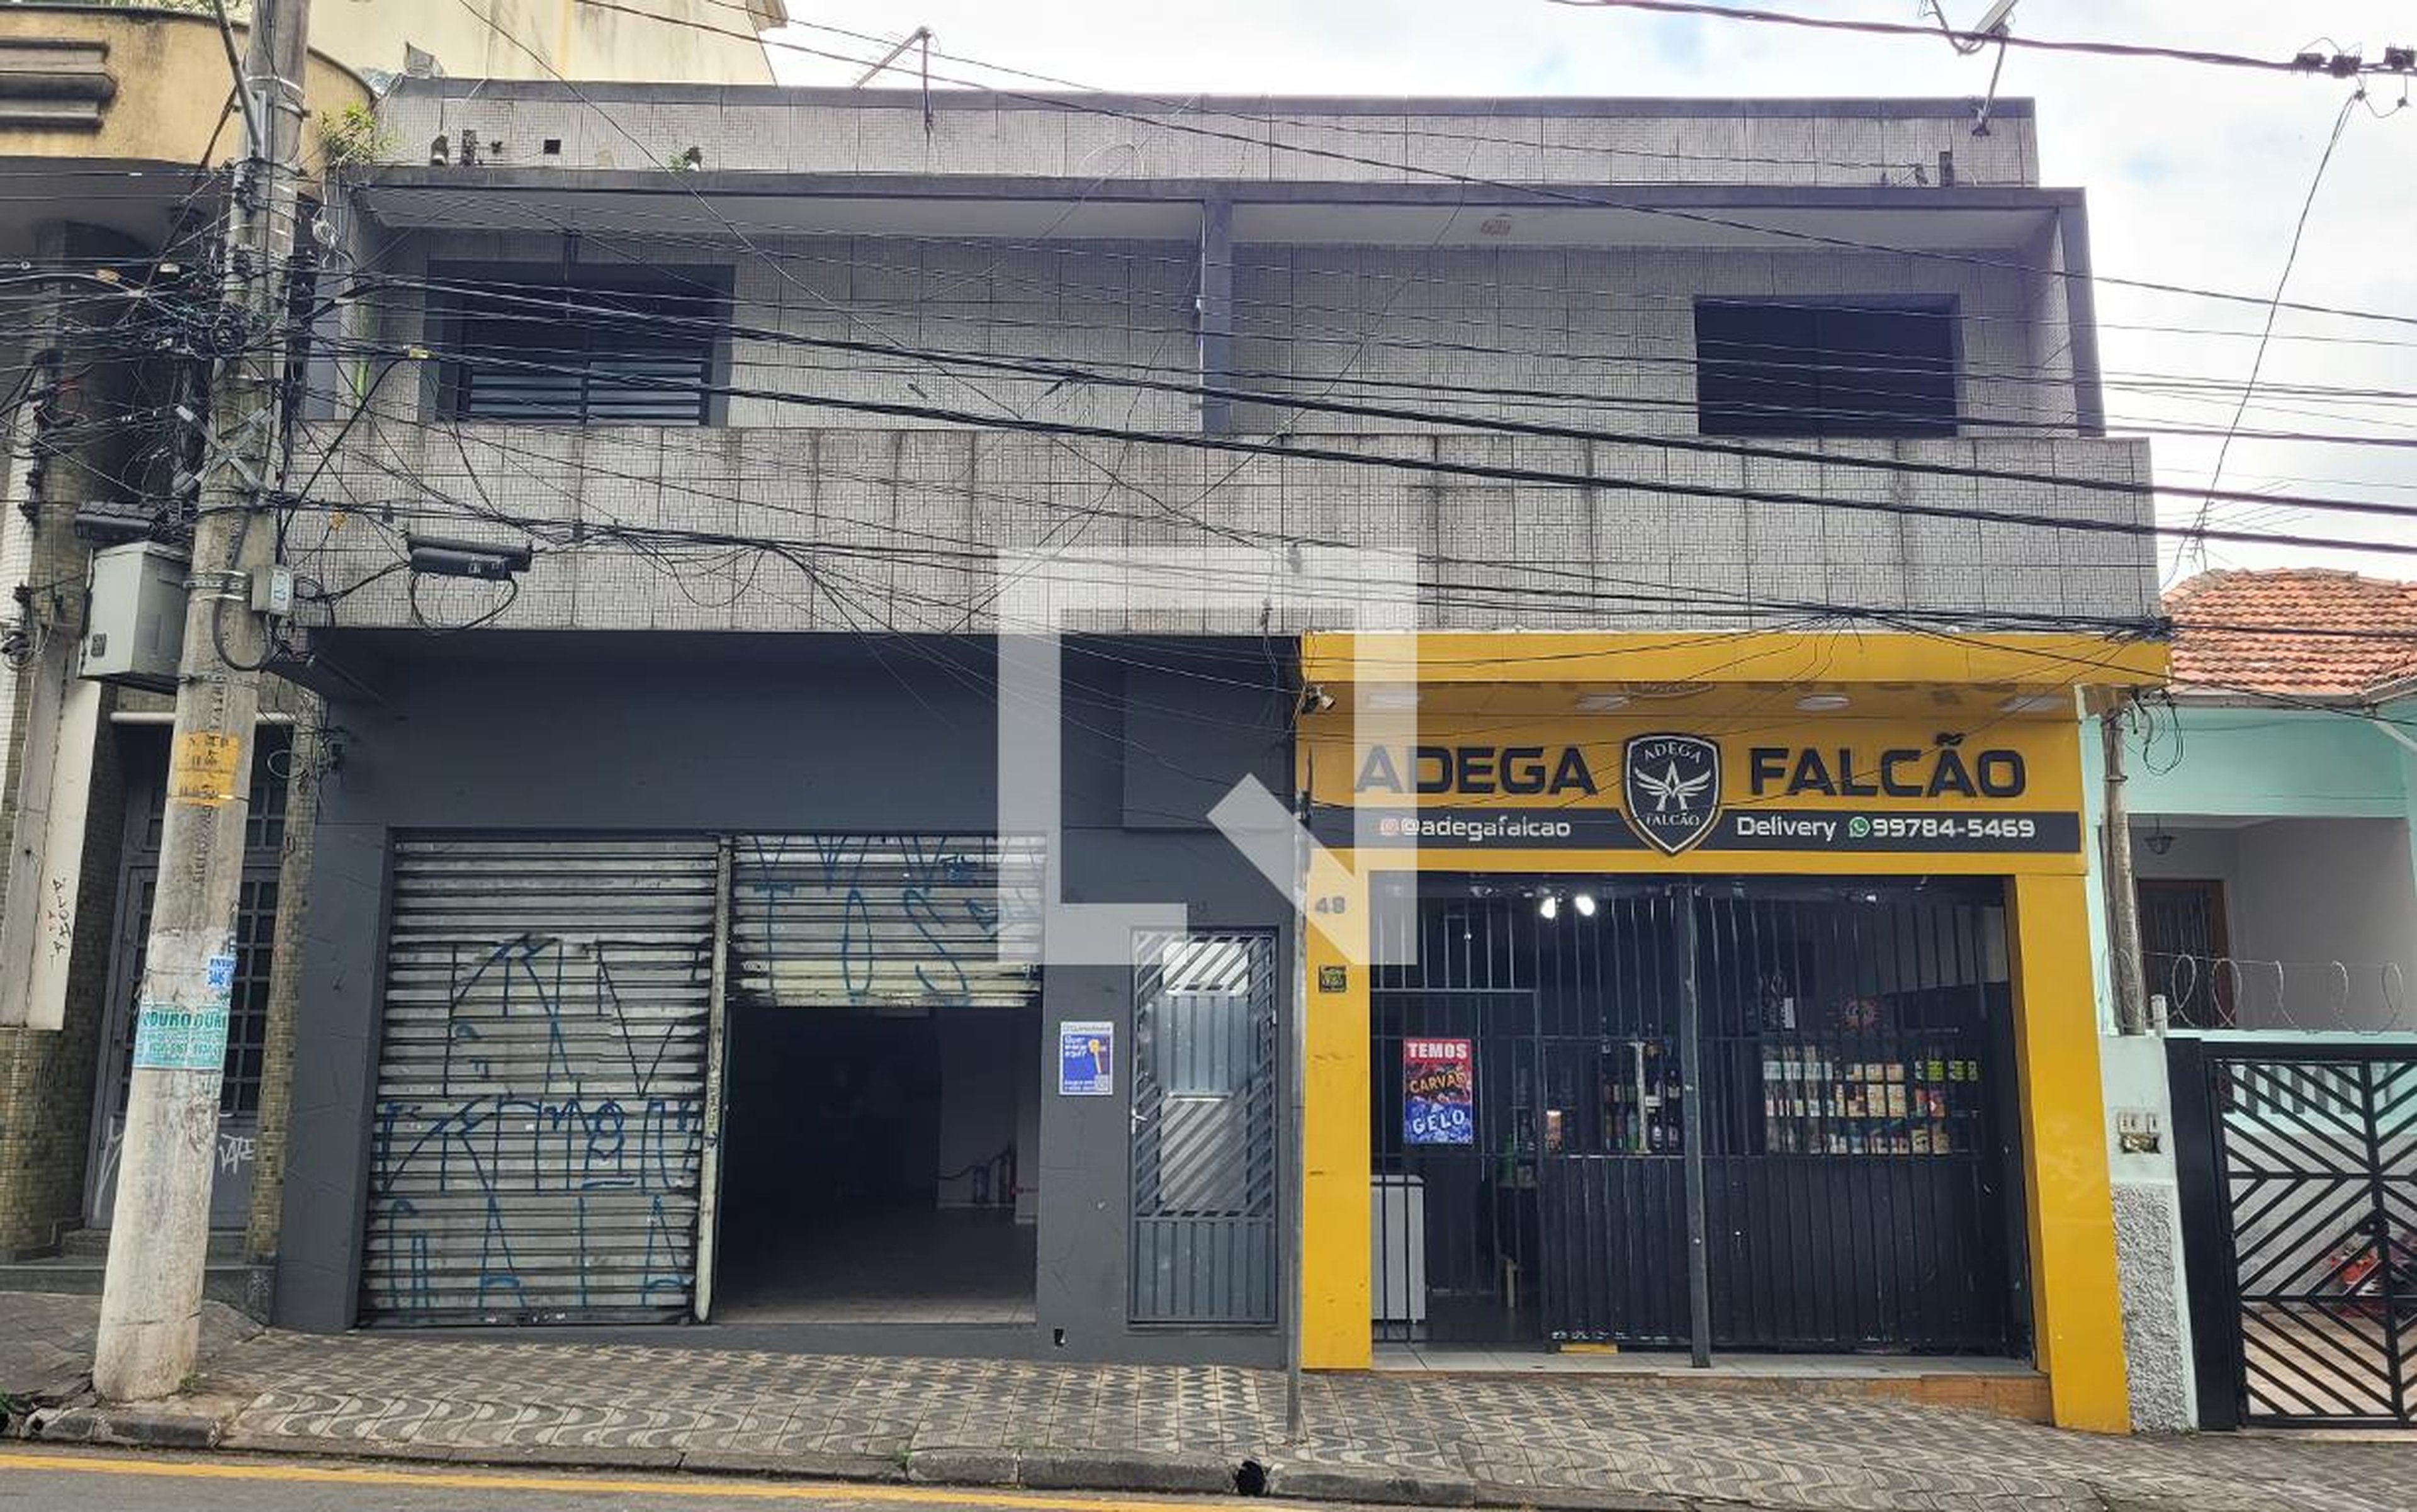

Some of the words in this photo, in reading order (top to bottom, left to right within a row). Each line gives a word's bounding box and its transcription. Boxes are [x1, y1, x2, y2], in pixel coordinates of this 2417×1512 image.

[1645, 742, 1701, 764] ADEGA
[1749, 732, 2026, 798] FALCÃO
[1355, 745, 1599, 795] ADEGA
[1645, 812, 1700, 826] FALCÃO
[1737, 816, 1837, 842] Delivery
[1872, 818, 2036, 838] 99784-5469
[1407, 1042, 1467, 1059] TEMOS
[1412, 1110, 1465, 1135] GELO
